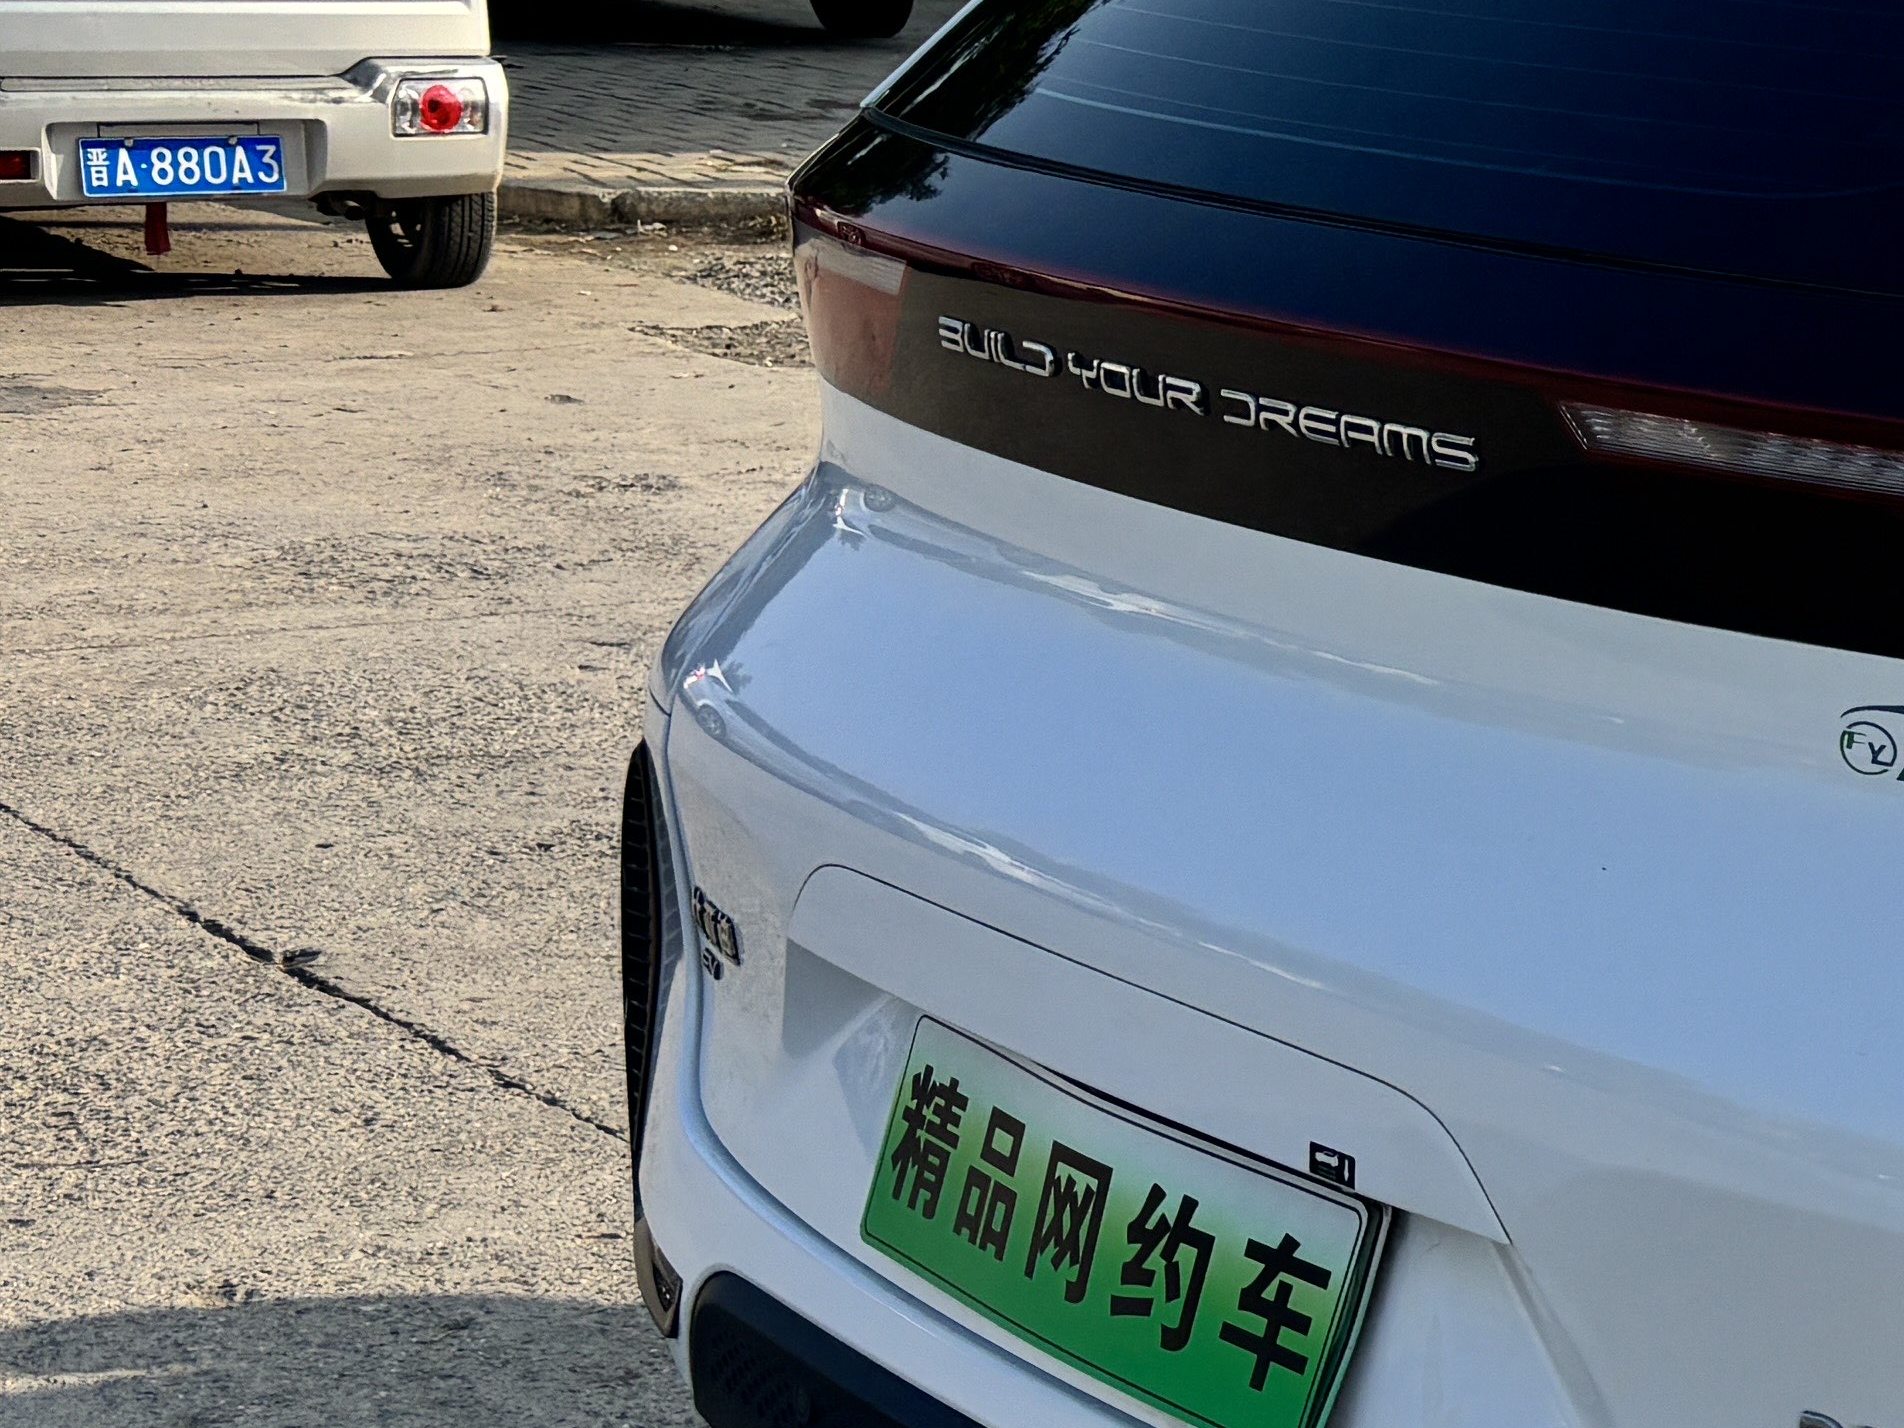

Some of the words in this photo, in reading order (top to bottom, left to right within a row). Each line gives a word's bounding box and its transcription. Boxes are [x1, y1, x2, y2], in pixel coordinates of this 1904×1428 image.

[937, 315, 1056, 378] BUILD
[1067, 350, 1203, 417] YOUR
[1220, 388, 1480, 472] DREAMS
[890, 1063, 1332, 1393] 精品网约车
